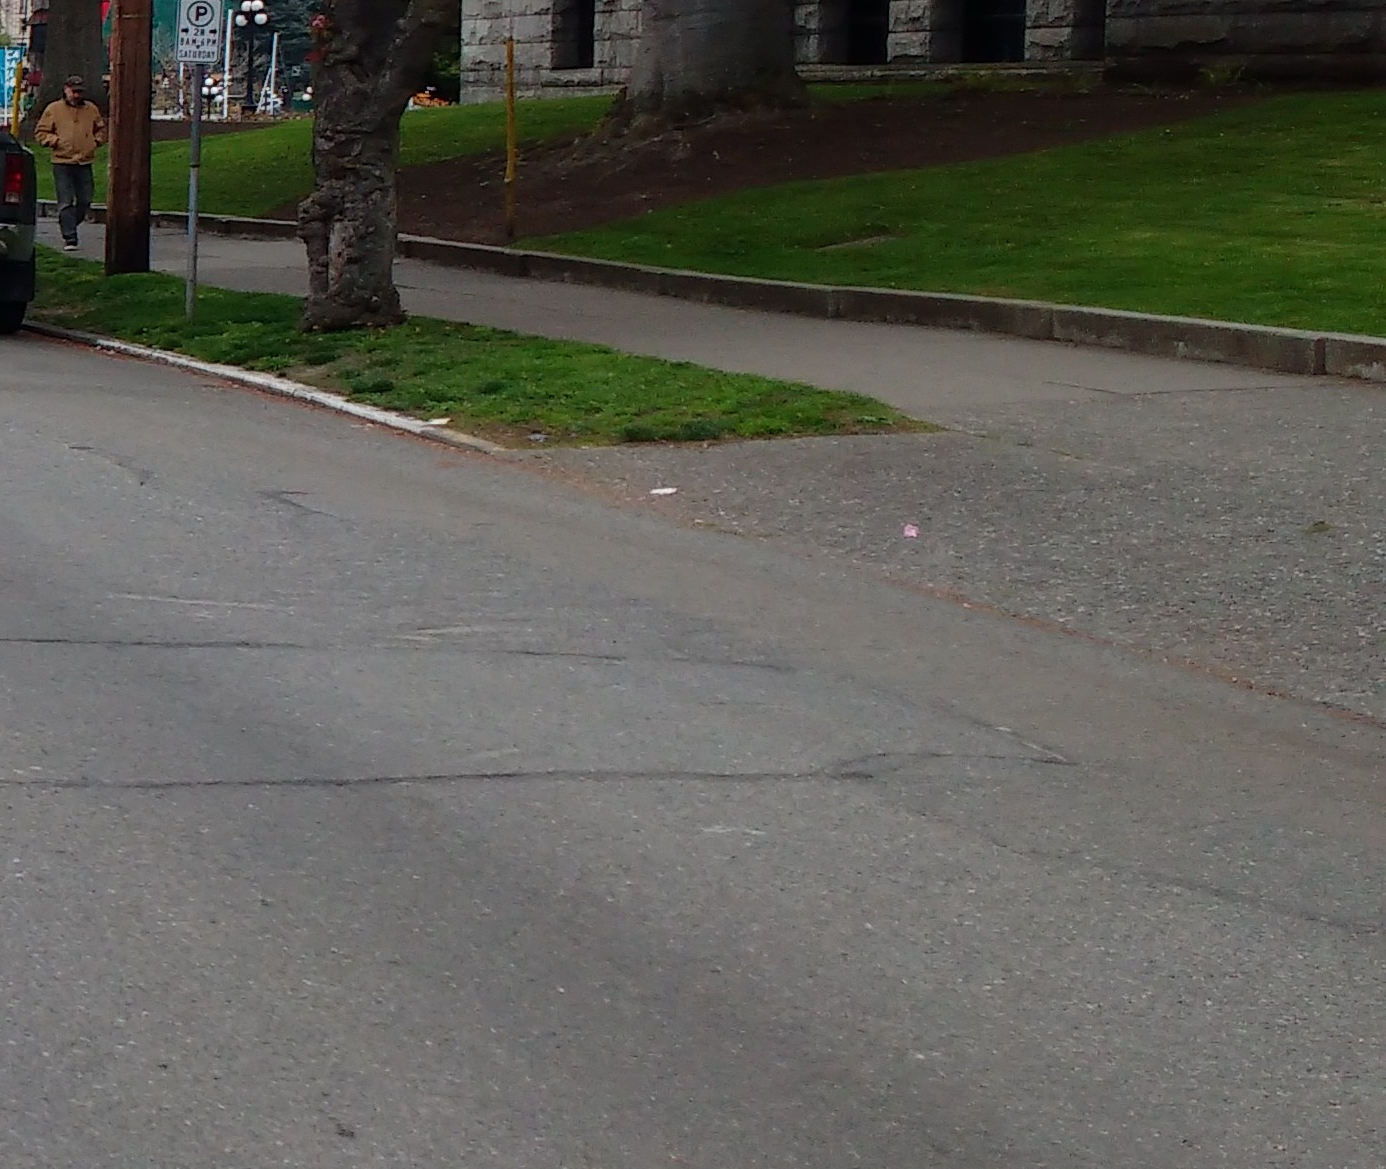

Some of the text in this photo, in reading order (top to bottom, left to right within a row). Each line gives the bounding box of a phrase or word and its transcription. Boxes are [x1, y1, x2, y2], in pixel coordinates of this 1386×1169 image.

[195, 6, 208, 21] P
[193, 28, 205, 37] 2H
[179, 50, 215, 59] SATURDAY
